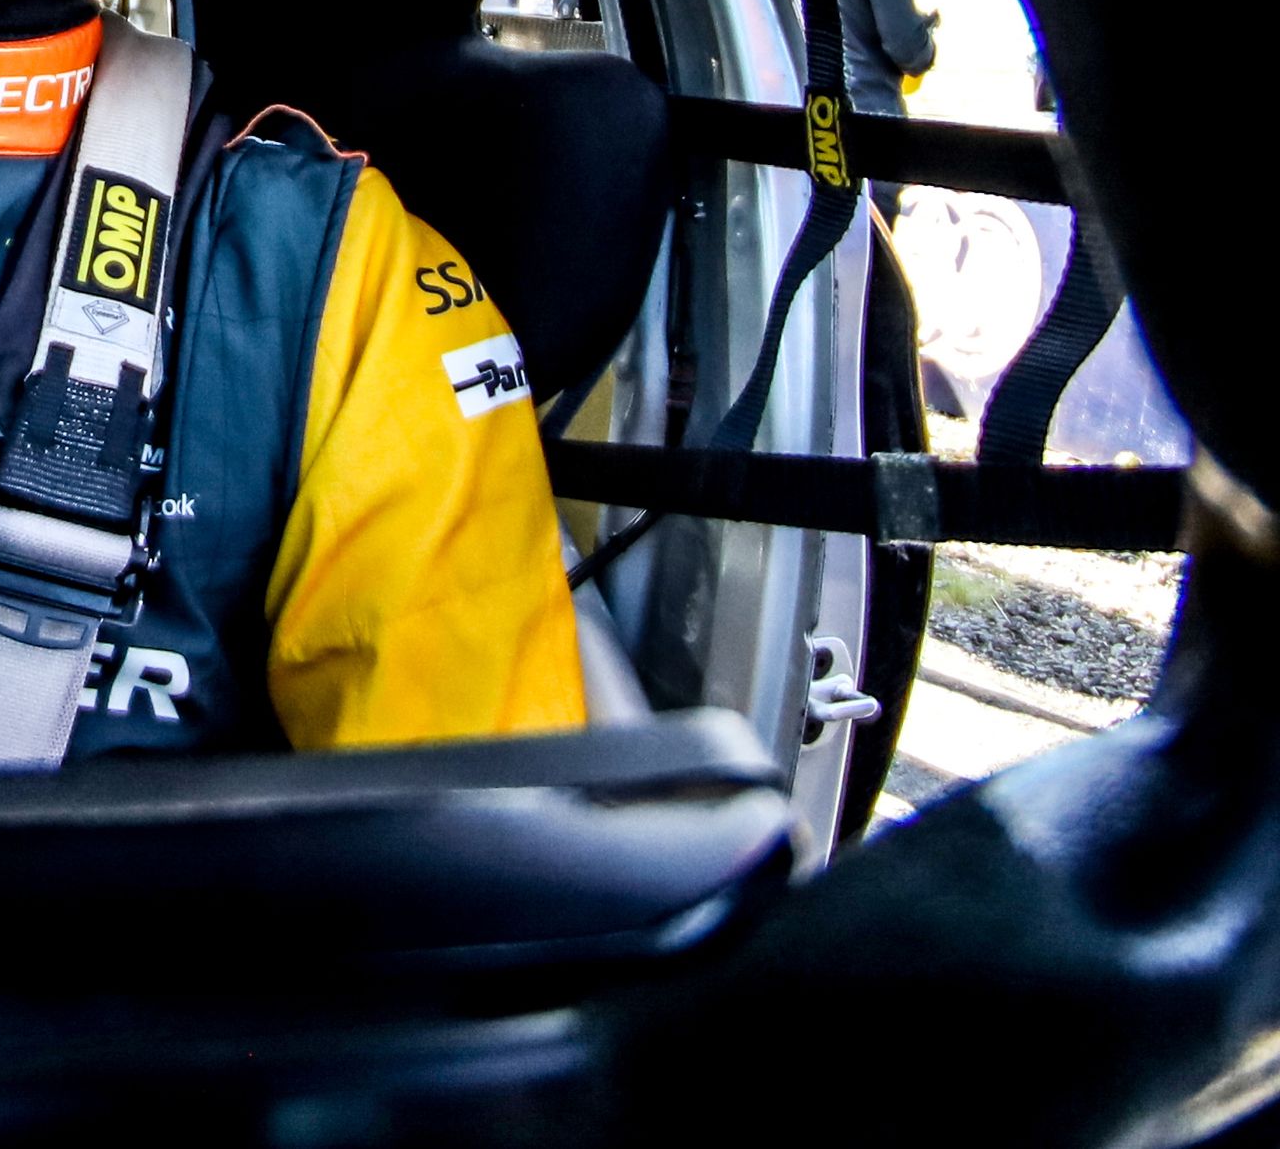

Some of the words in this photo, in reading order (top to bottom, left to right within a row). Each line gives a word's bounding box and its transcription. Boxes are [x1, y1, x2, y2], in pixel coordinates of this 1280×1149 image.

[811, 95, 842, 186] OMP
[92, 184, 146, 289] OMP
[474, 350, 528, 398] Par
